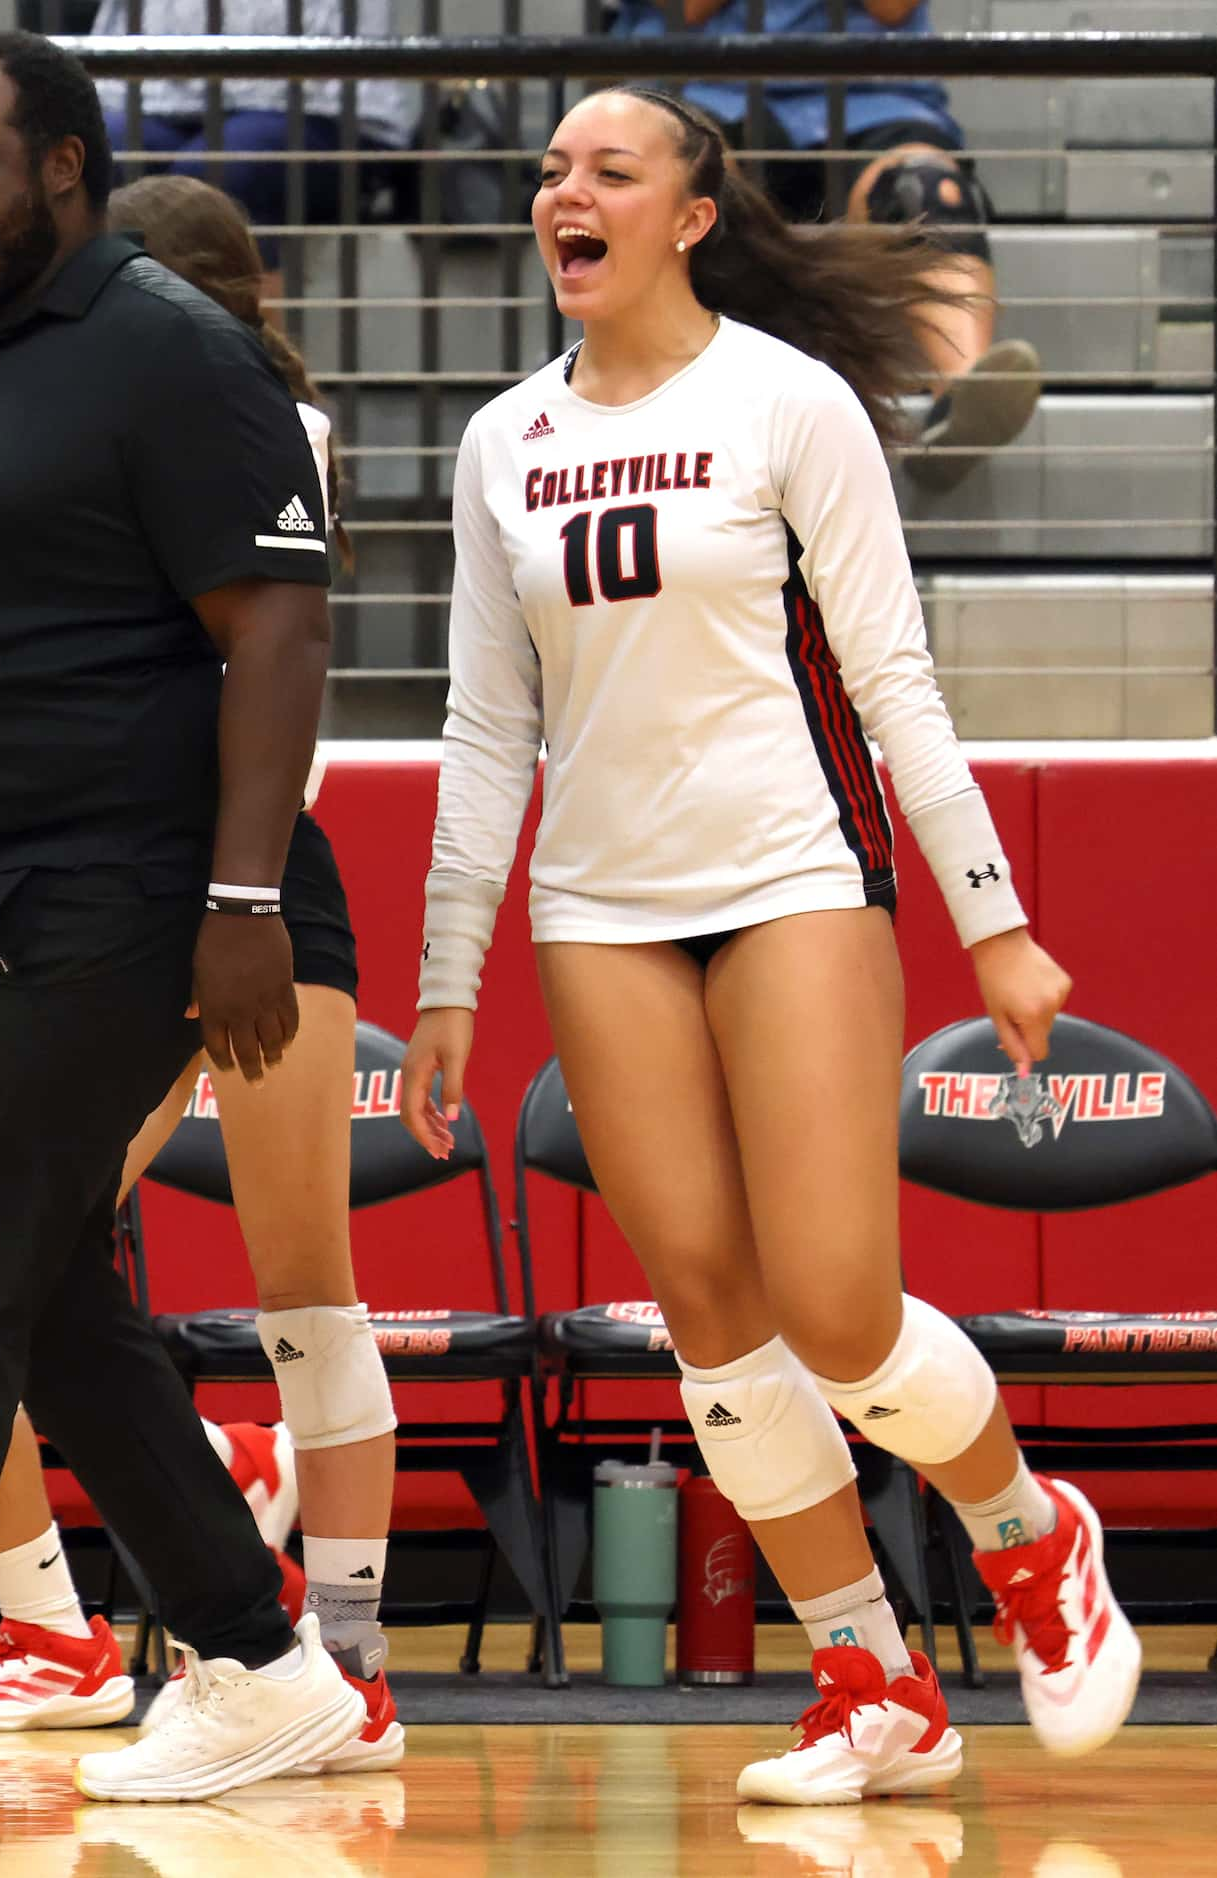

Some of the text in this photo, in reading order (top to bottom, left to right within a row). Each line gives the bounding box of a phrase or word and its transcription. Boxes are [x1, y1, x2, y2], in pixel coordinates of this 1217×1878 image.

[522, 427, 555, 441] adidas
[525, 452, 713, 512] COLLEYVILLE
[276, 517, 315, 532] adidas
[559, 502, 663, 607] 10
[919, 1072, 1166, 1140] THE VILLE
[705, 1416, 741, 1427] adidas
